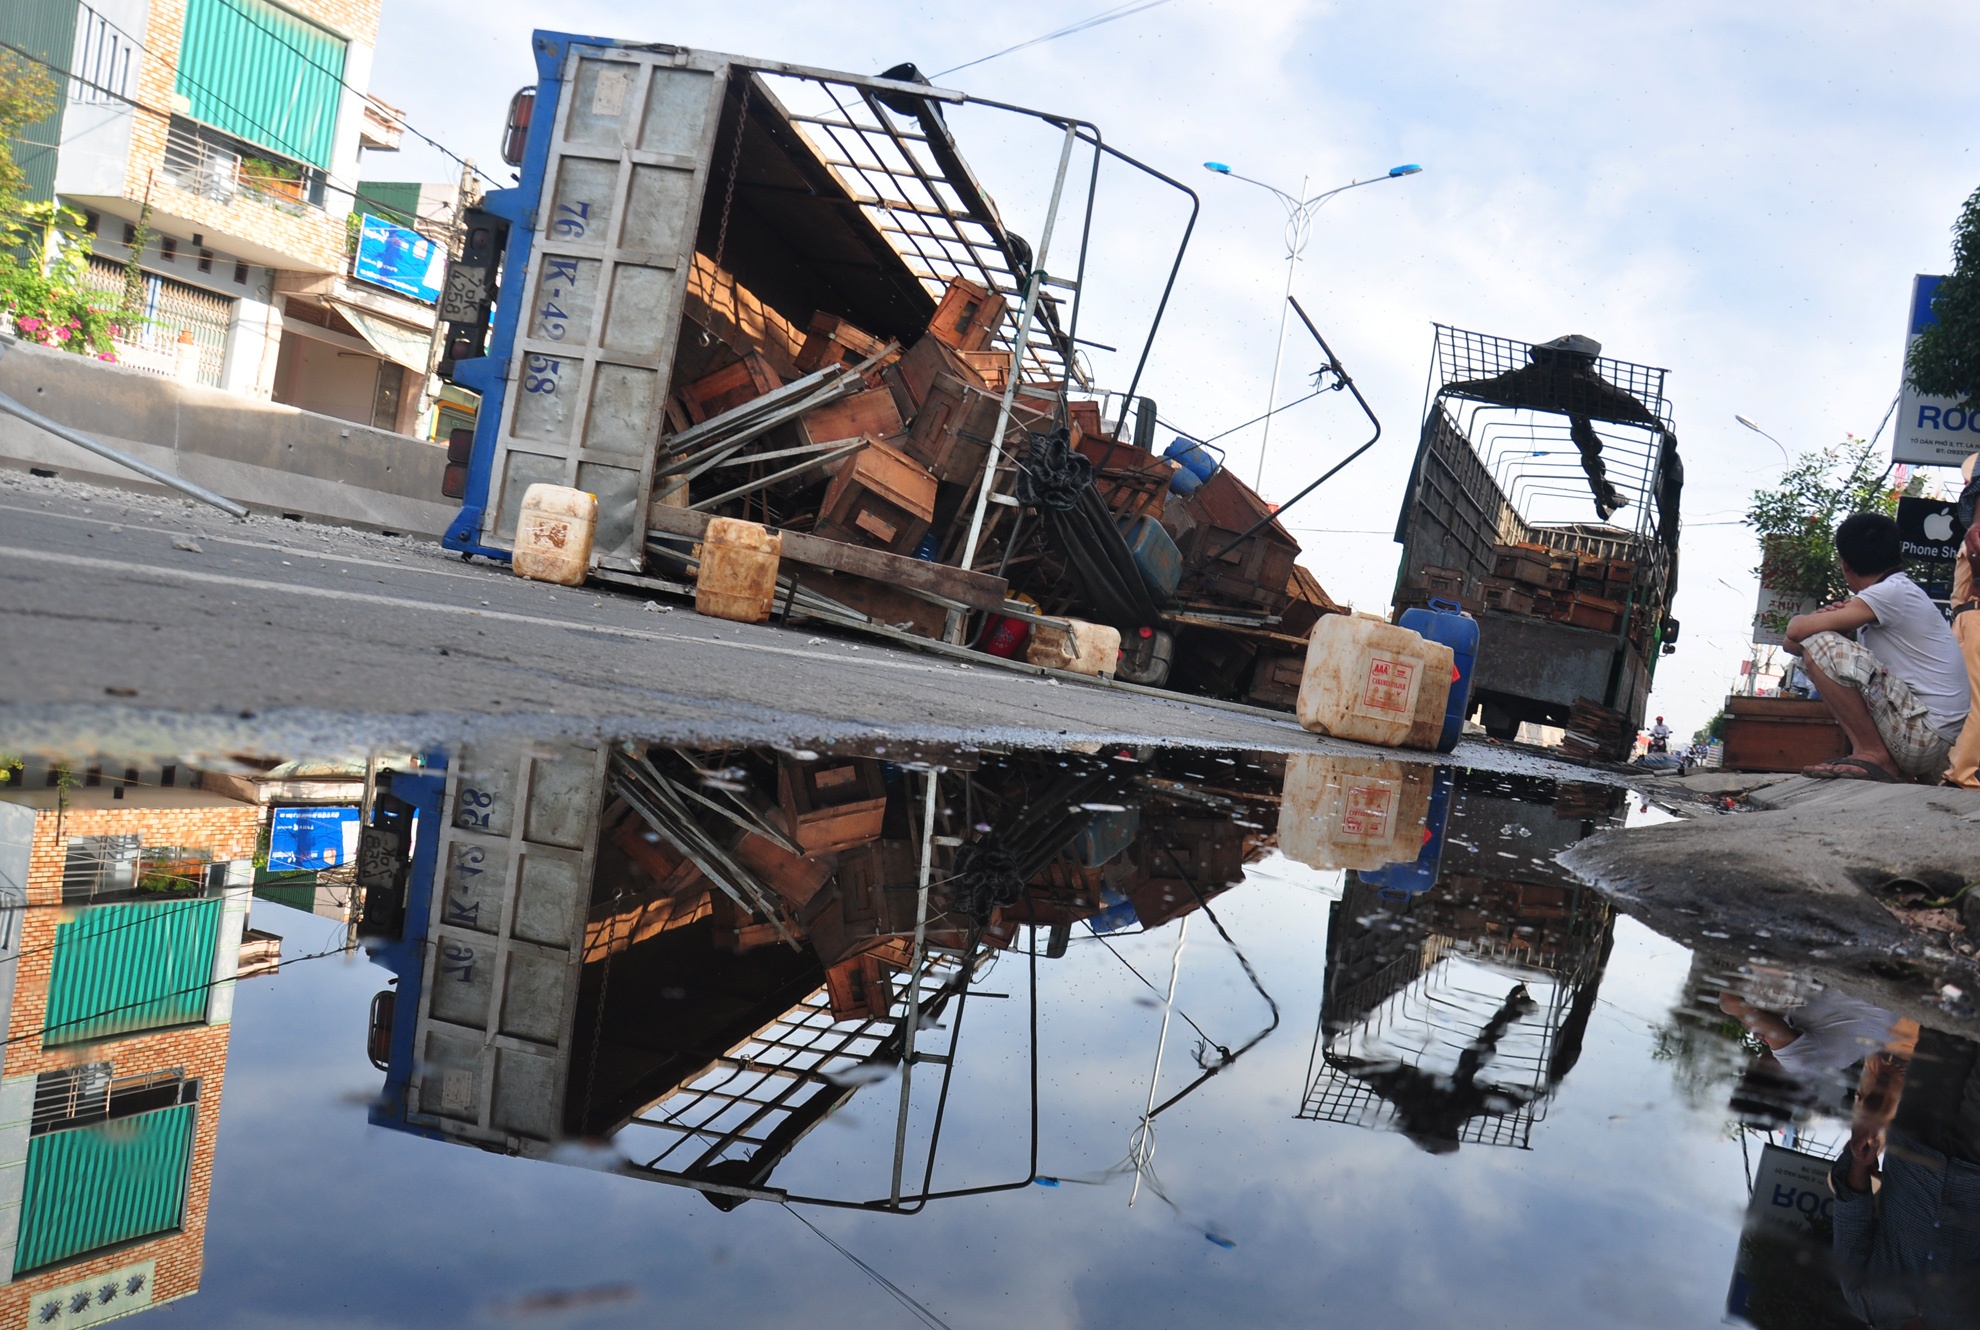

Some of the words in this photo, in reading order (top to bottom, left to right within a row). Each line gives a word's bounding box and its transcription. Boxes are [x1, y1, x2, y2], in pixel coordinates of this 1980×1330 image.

[554, 201, 590, 238] 76
[444, 268, 466, 316] 4258
[539, 260, 578, 341] K-42
[524, 355, 560, 395] 58
[1941, 545, 1958, 559] Sh
